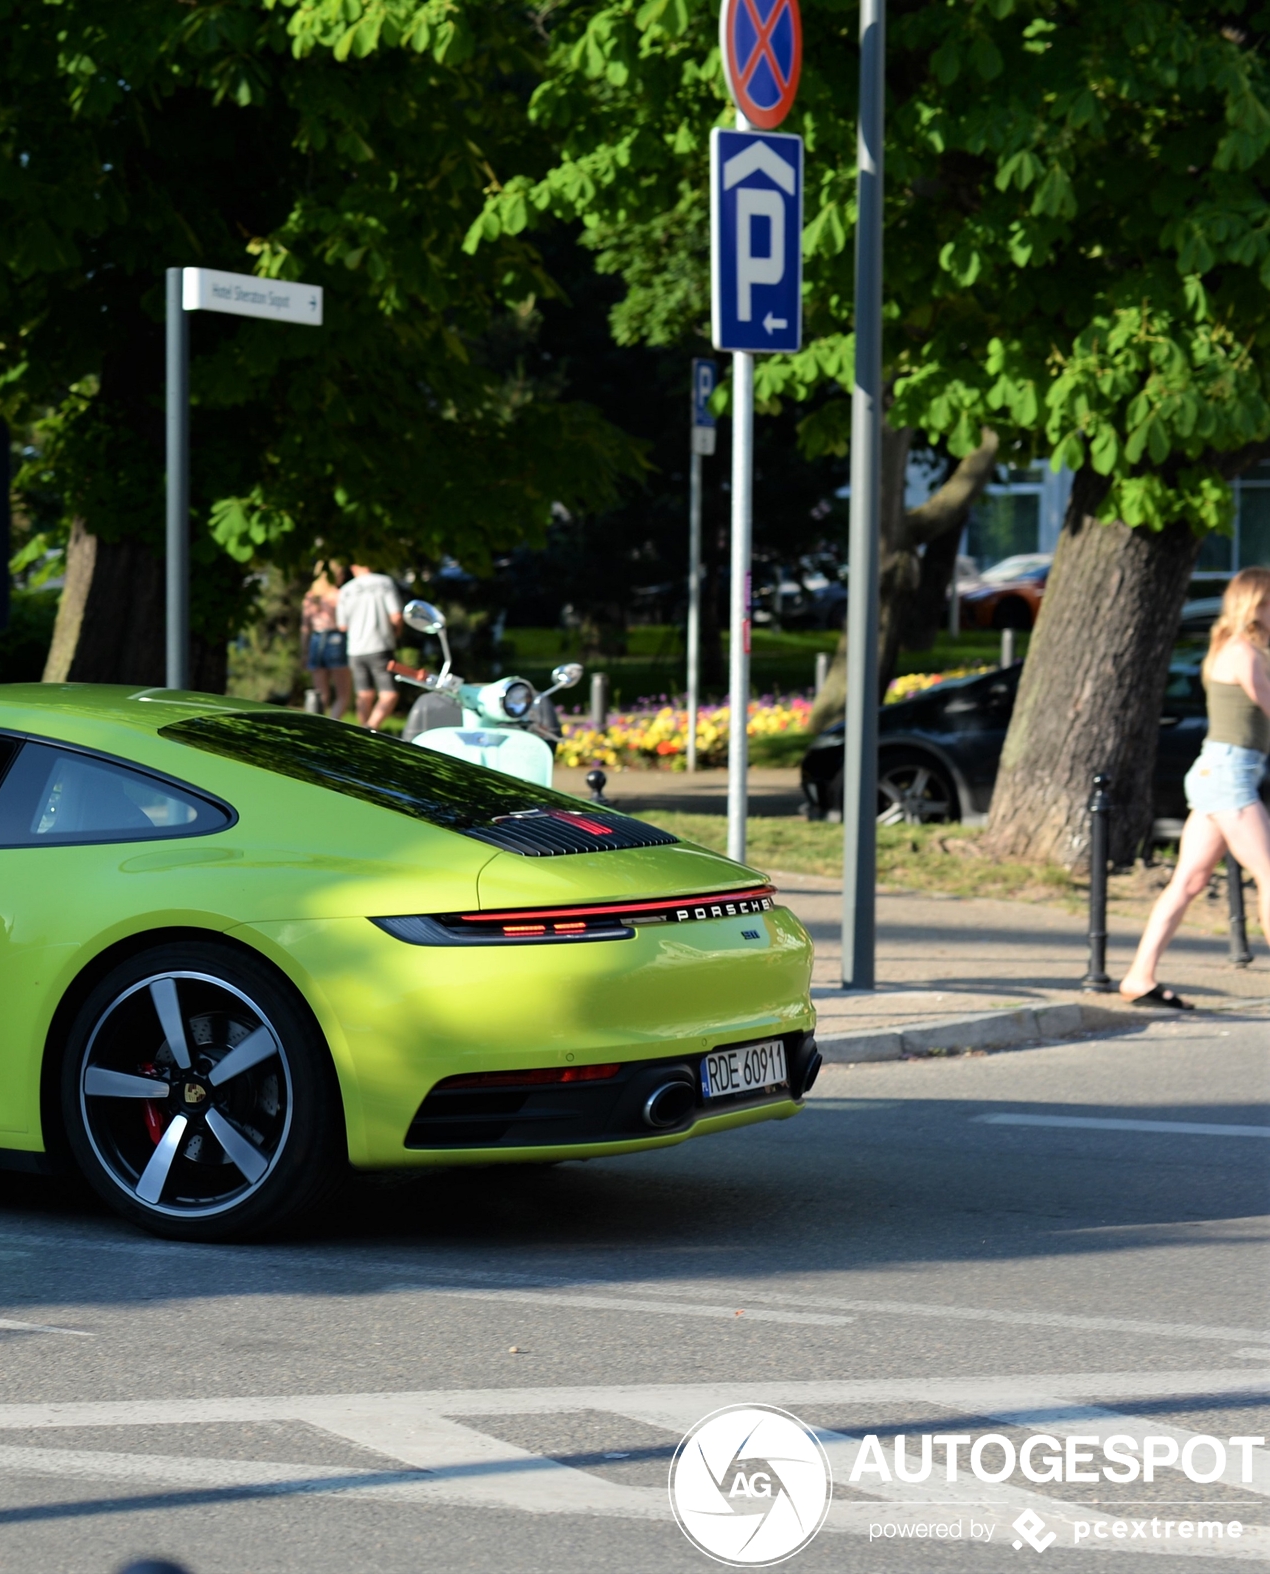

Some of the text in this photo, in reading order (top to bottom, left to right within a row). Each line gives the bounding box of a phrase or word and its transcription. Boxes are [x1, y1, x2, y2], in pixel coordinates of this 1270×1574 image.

[736, 187, 785, 322] P
[212, 282, 232, 300] Hotel
[235, 285, 267, 305] Sheraton
[699, 365, 713, 406] P
[676, 898, 770, 922] PORSCHE
[708, 1043, 783, 1094] RDE 60911
